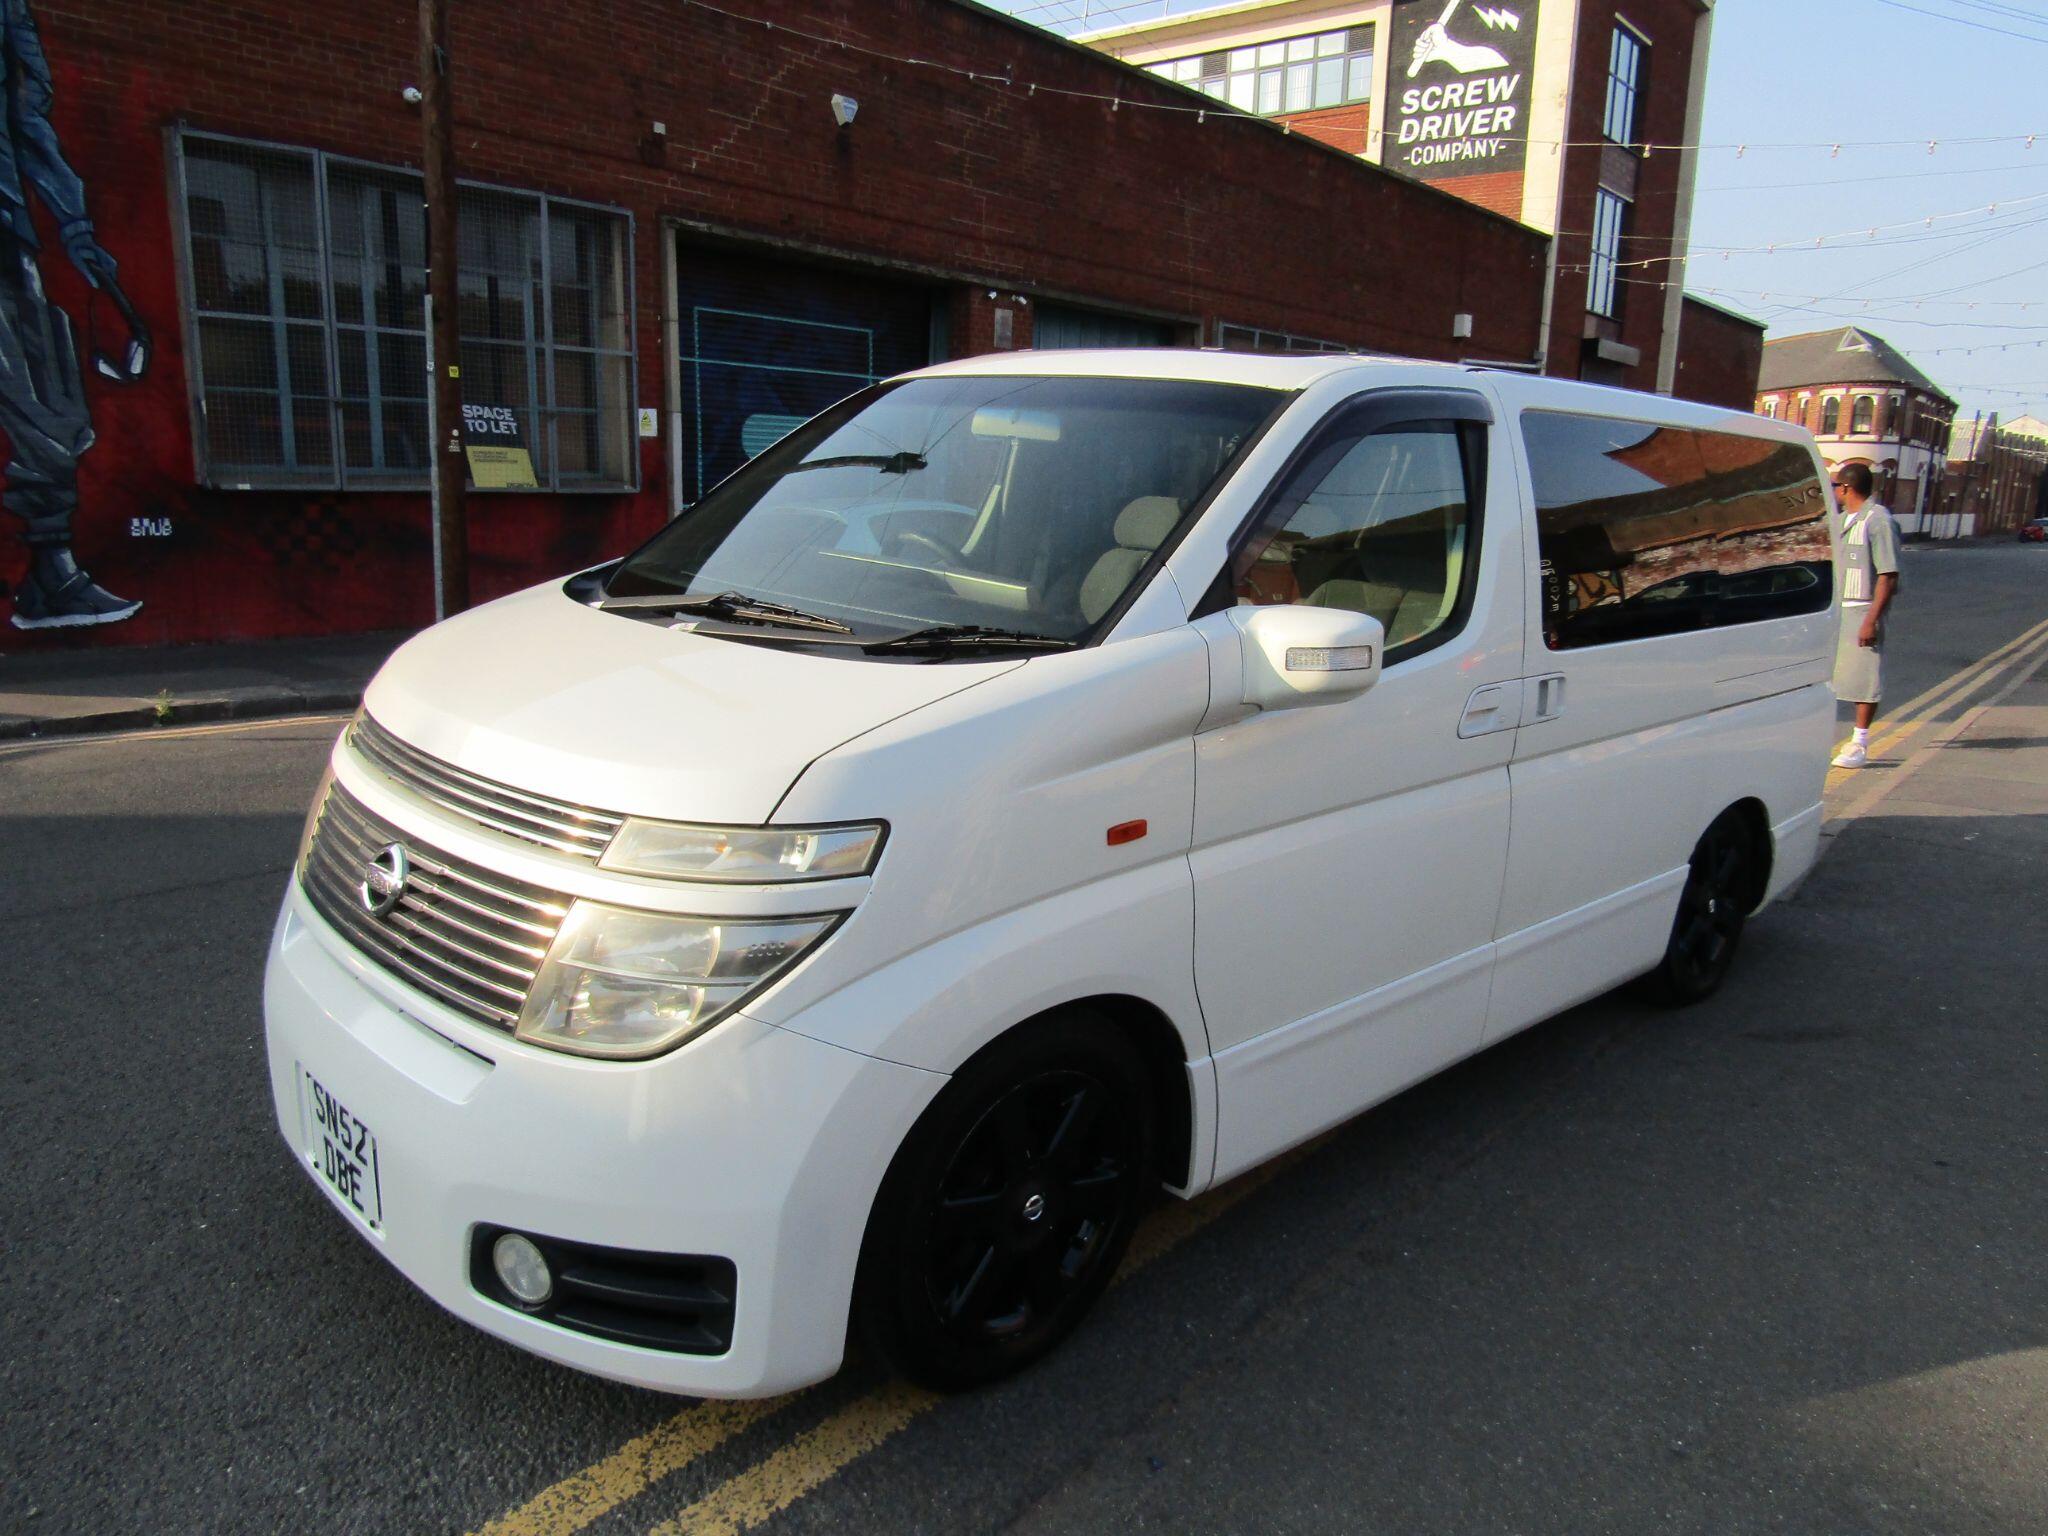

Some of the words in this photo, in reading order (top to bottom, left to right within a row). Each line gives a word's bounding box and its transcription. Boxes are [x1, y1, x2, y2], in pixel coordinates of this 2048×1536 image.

[1400, 74, 1520, 115] SCREW
[1398, 105, 1516, 145] DRIVER
[462, 404, 513, 420] SPACE
[465, 419, 488, 432] TO
[491, 420, 517, 434] LET
[313, 1079, 369, 1167] SN52
[323, 1134, 365, 1213] DBE
